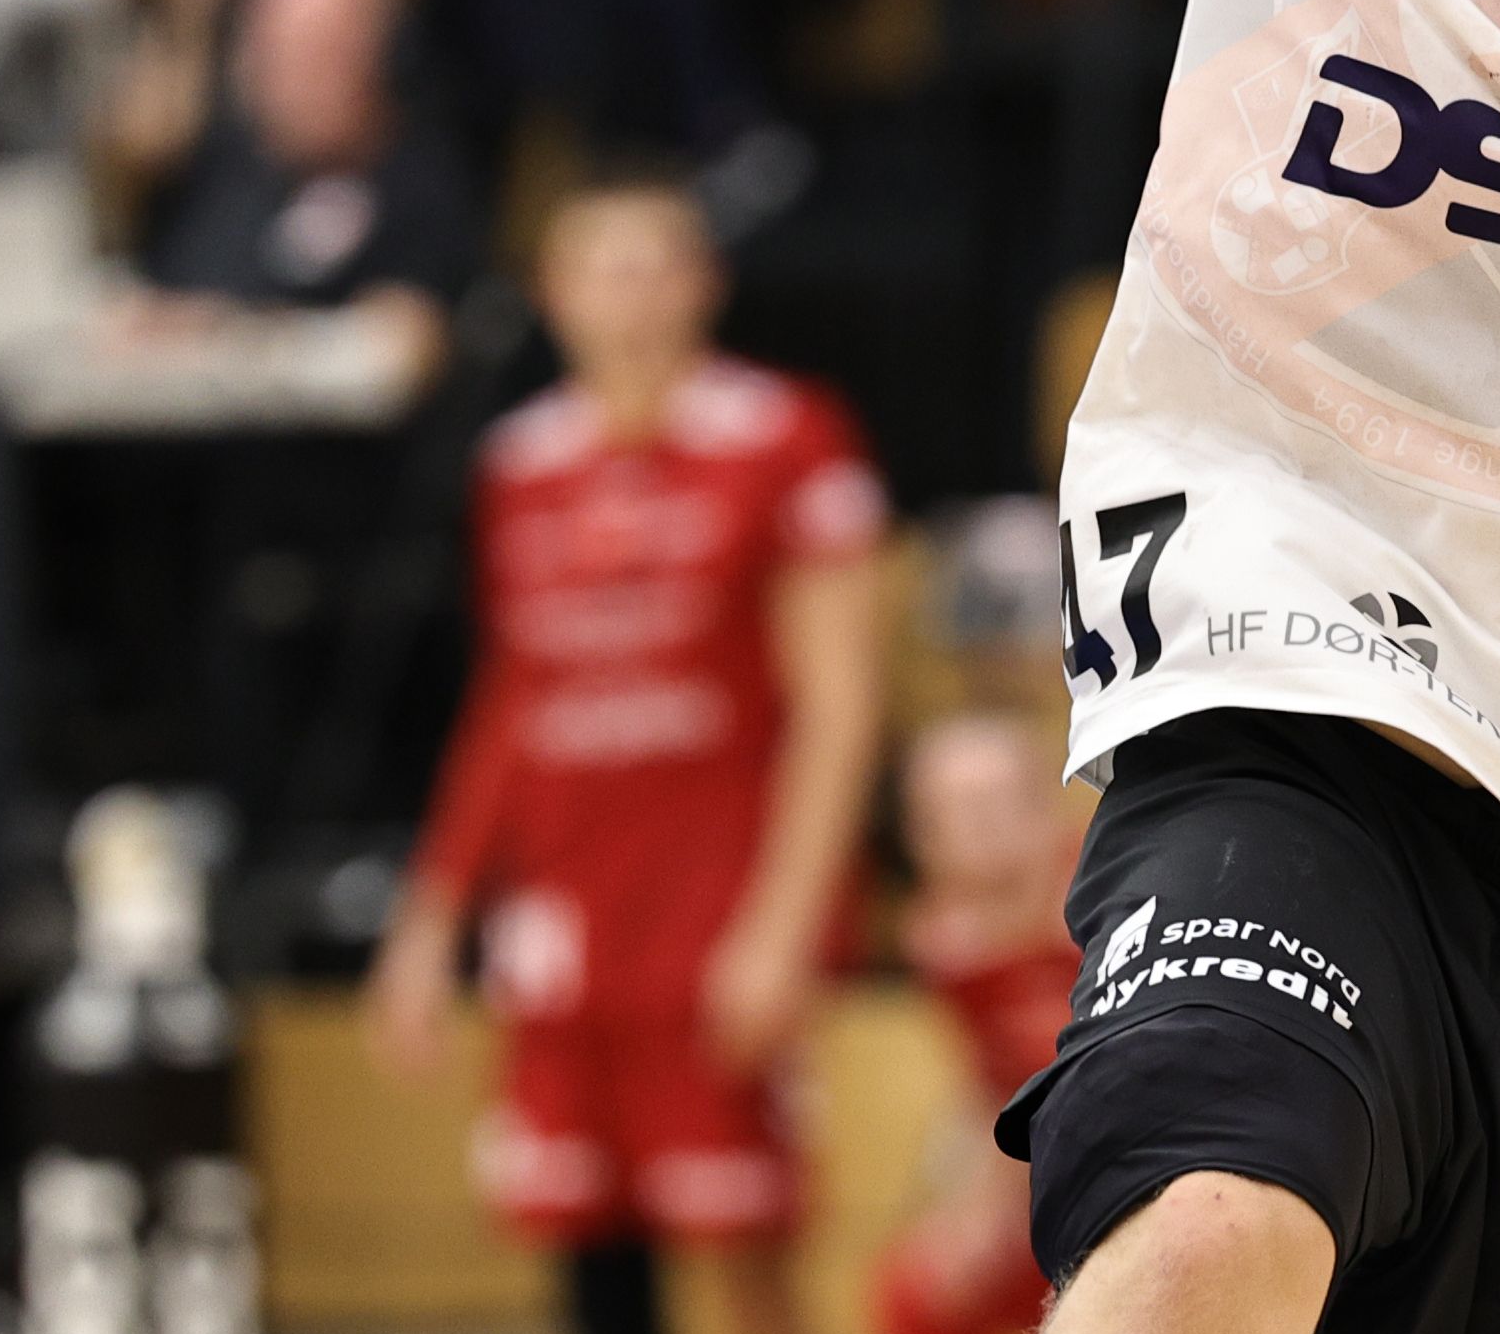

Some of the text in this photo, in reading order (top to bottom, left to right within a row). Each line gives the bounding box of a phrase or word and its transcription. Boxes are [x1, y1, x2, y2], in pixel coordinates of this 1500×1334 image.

[1311, 385, 1411, 458] 1994
[1059, 491, 1187, 693] 47
[1207, 609, 1268, 656] HF
[1160, 917, 1265, 945] spar
